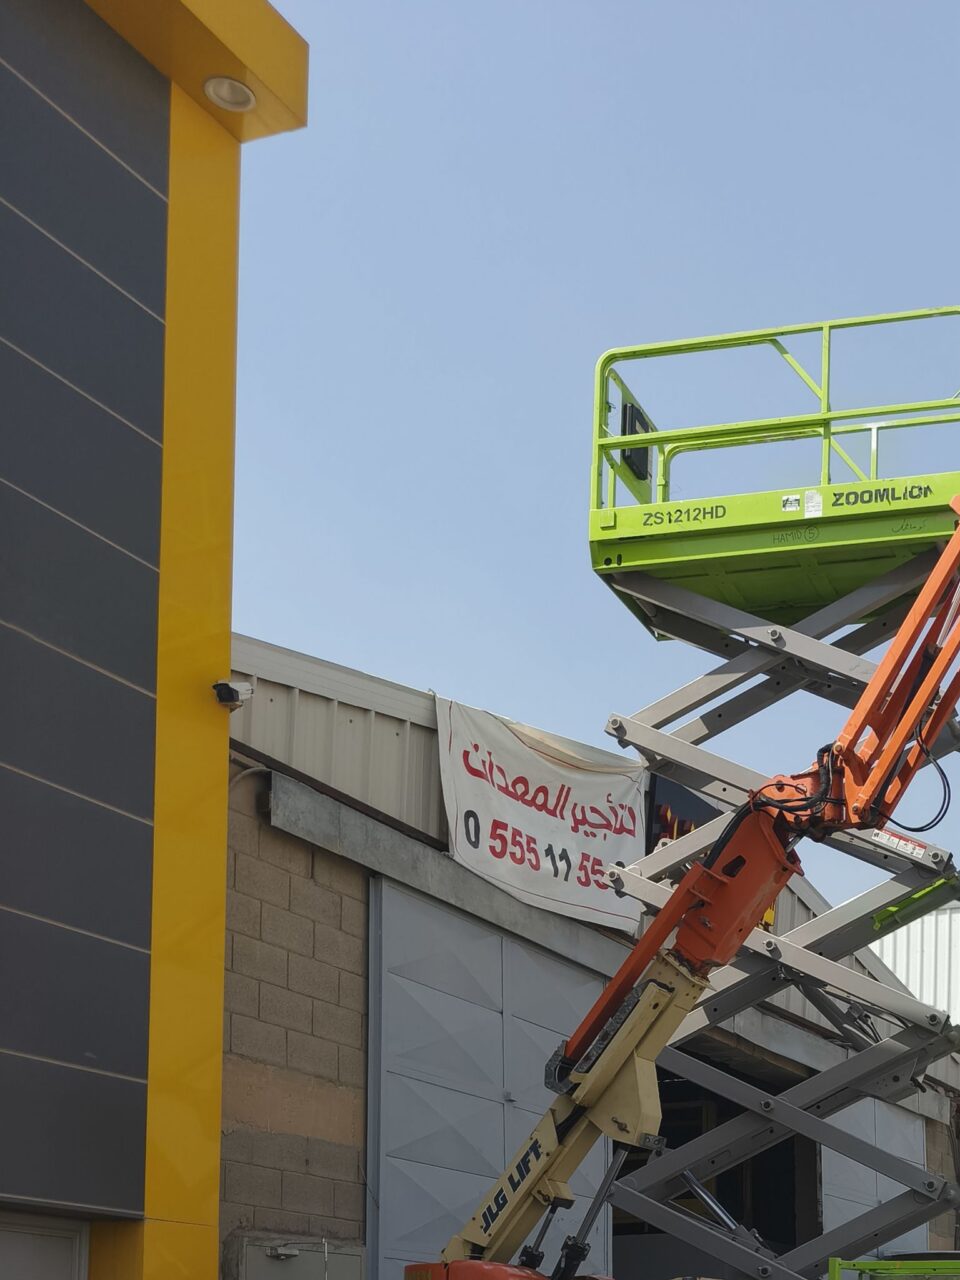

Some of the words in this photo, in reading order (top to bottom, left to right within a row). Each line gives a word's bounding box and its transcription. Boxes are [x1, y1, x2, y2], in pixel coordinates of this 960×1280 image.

[643, 505, 727, 527] ZS1212HD
[462, 743, 572, 821] المعدات
[481, 1187, 509, 1234] JLG
[507, 1138, 542, 1193] LIFT
